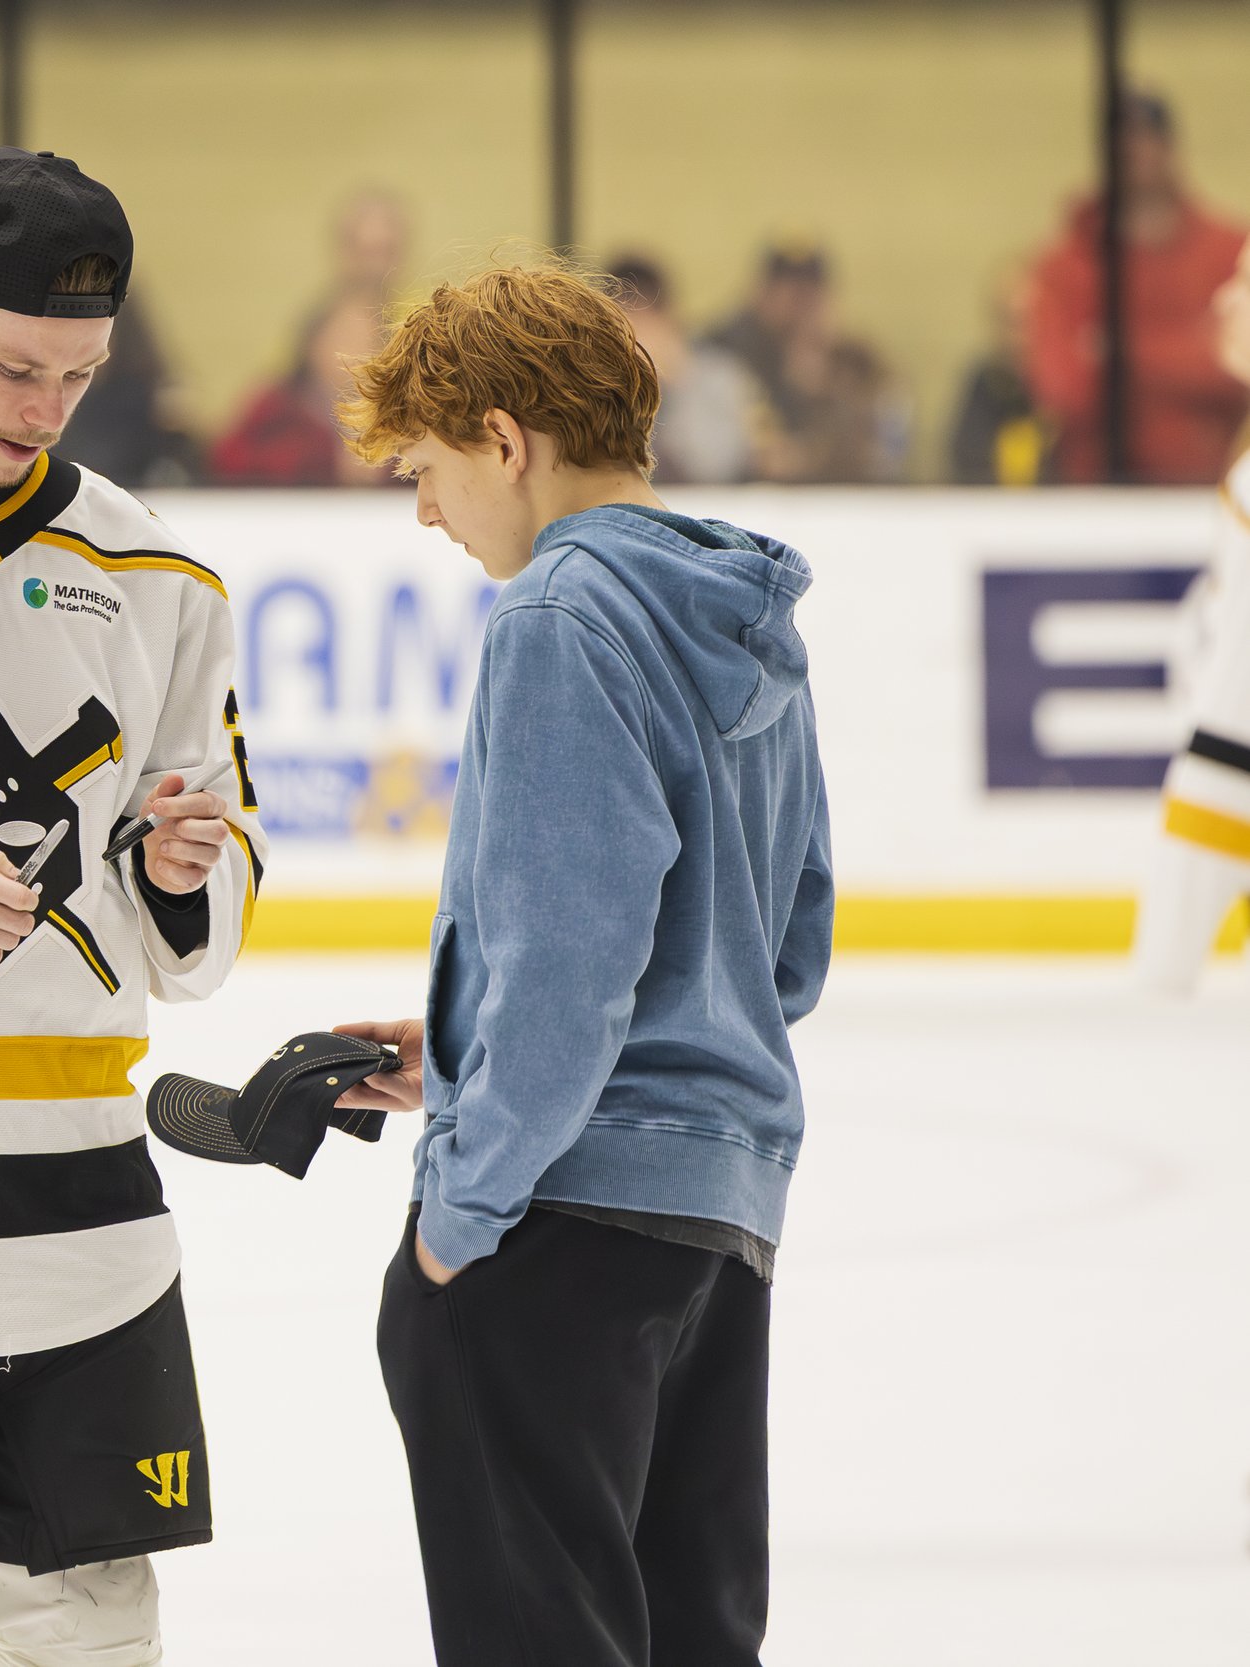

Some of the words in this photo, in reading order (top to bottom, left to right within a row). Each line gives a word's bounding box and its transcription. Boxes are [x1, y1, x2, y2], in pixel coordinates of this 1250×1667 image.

[53, 584, 122, 614] MATHESON
[53, 600, 66, 611] The
[66, 602, 80, 612] Gas
